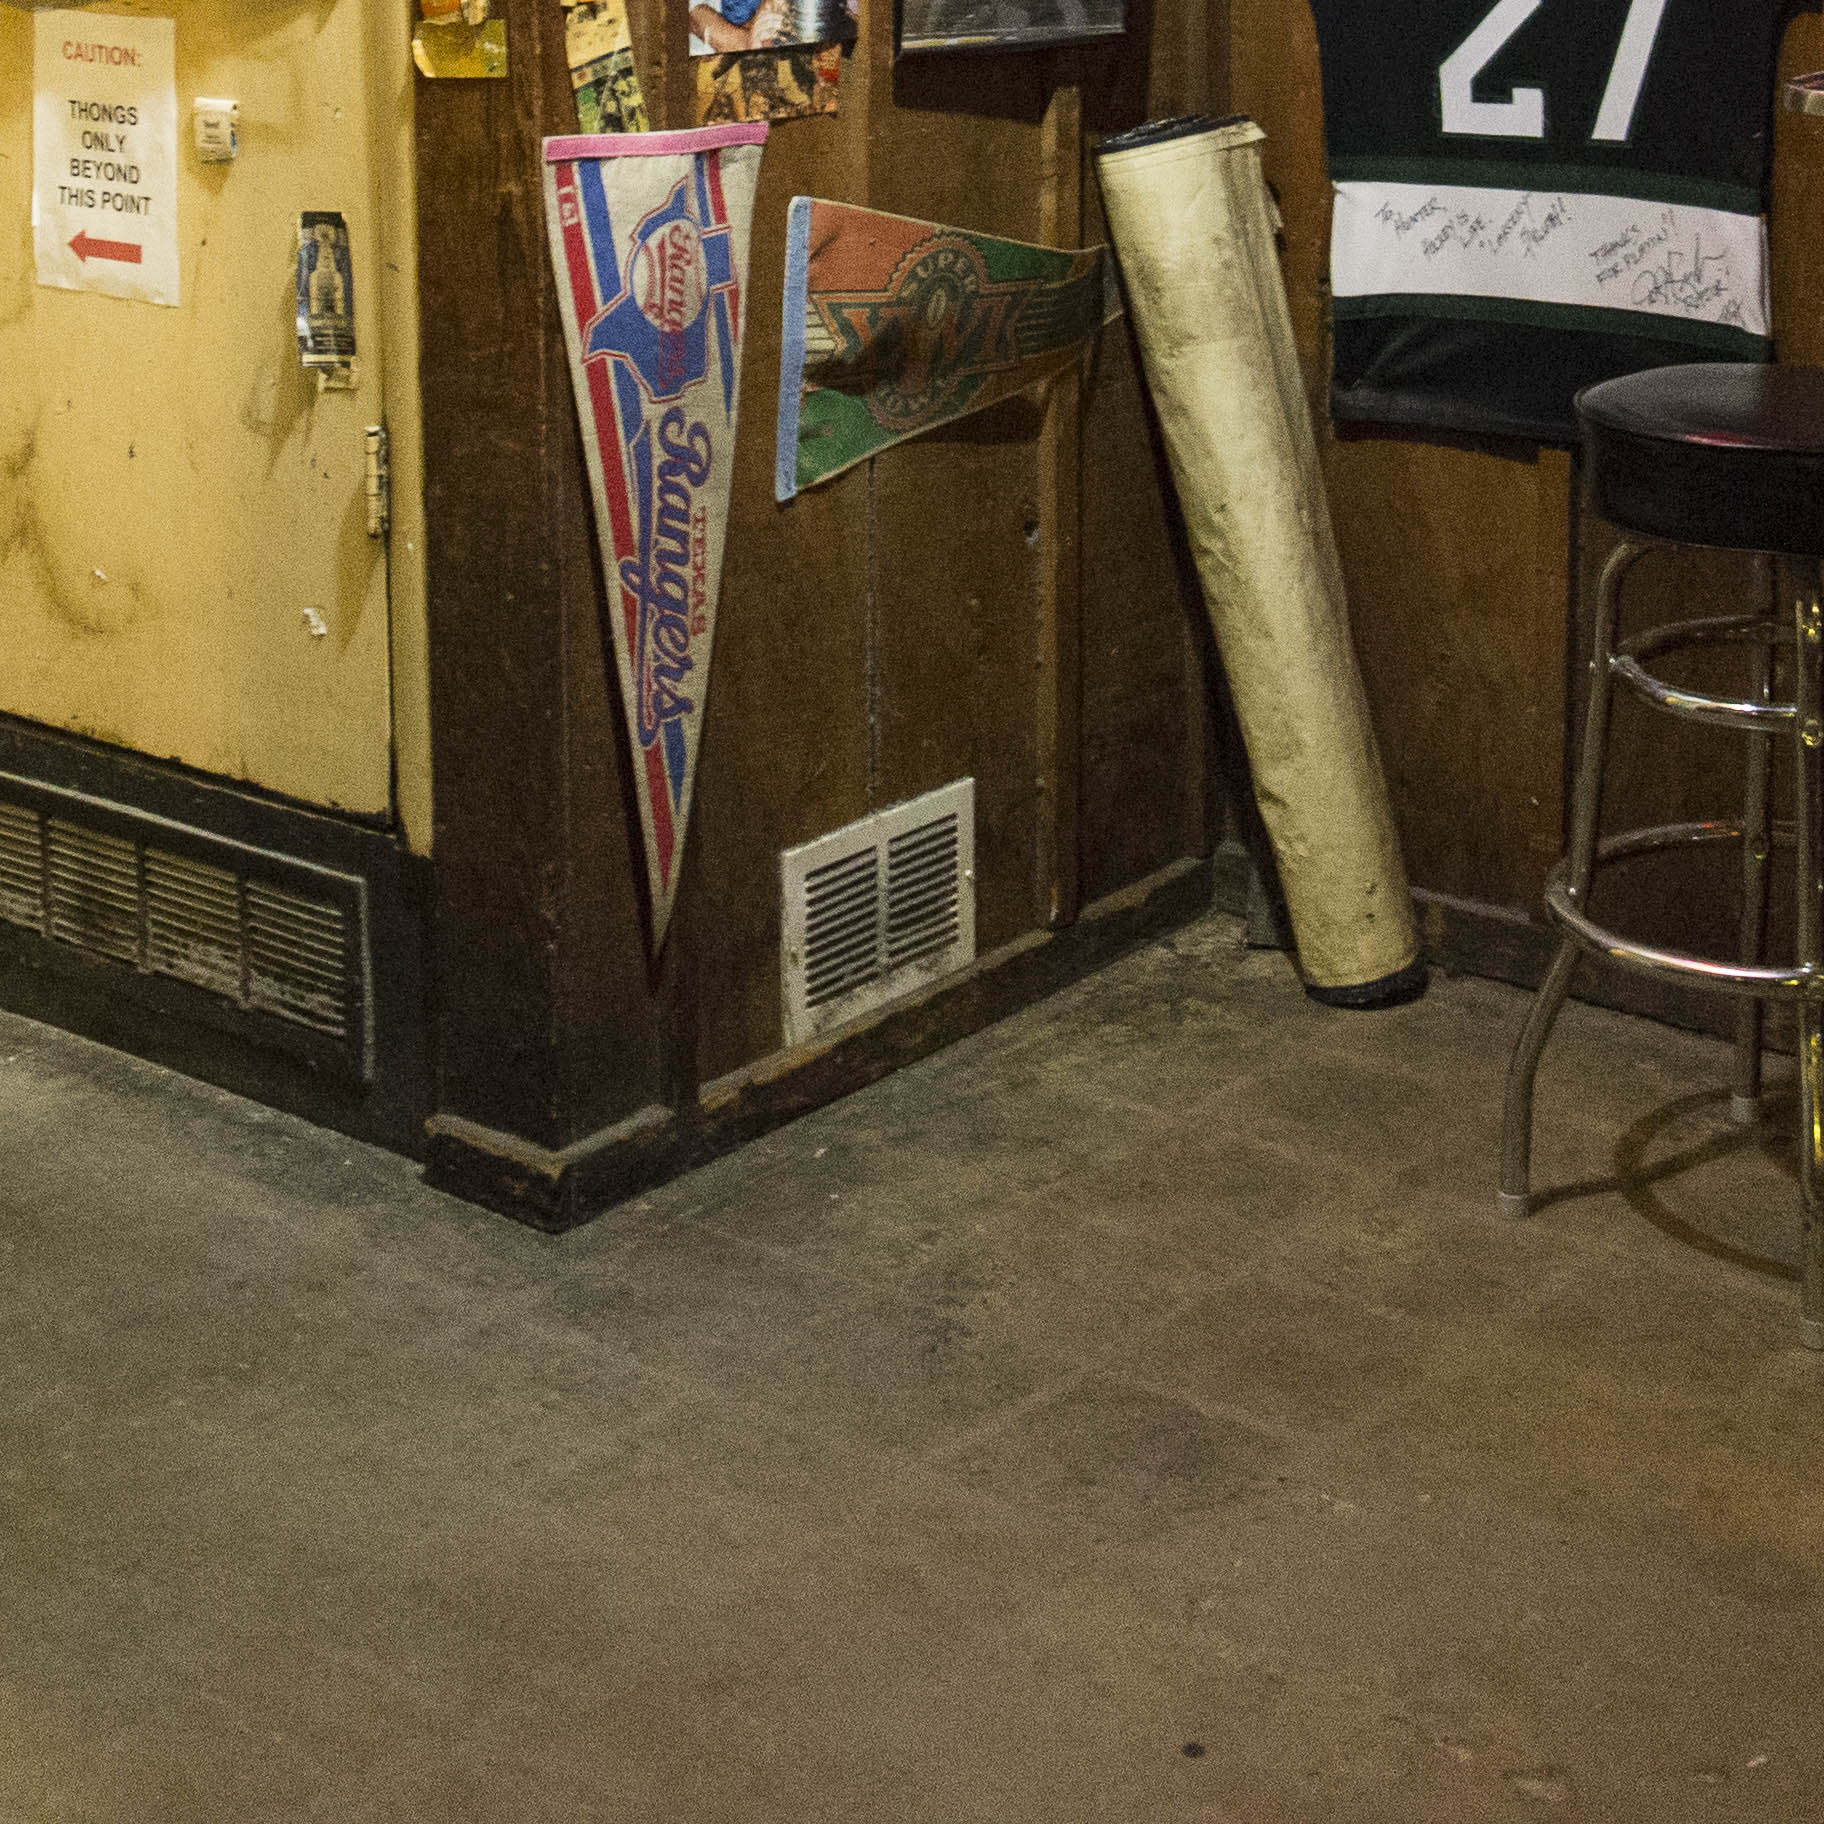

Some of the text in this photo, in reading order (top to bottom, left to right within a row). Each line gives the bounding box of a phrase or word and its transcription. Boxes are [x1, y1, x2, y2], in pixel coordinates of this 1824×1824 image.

[62, 39, 143, 68] CAUTION:
[67, 99, 139, 126] THONGS
[81, 130, 127, 154] ONLY
[69, 159, 142, 186] BEYOND
[57, 185, 153, 216] THIS POINT
[619, 406, 714, 734] Rangers
[690, 505, 708, 637] TEXAS
